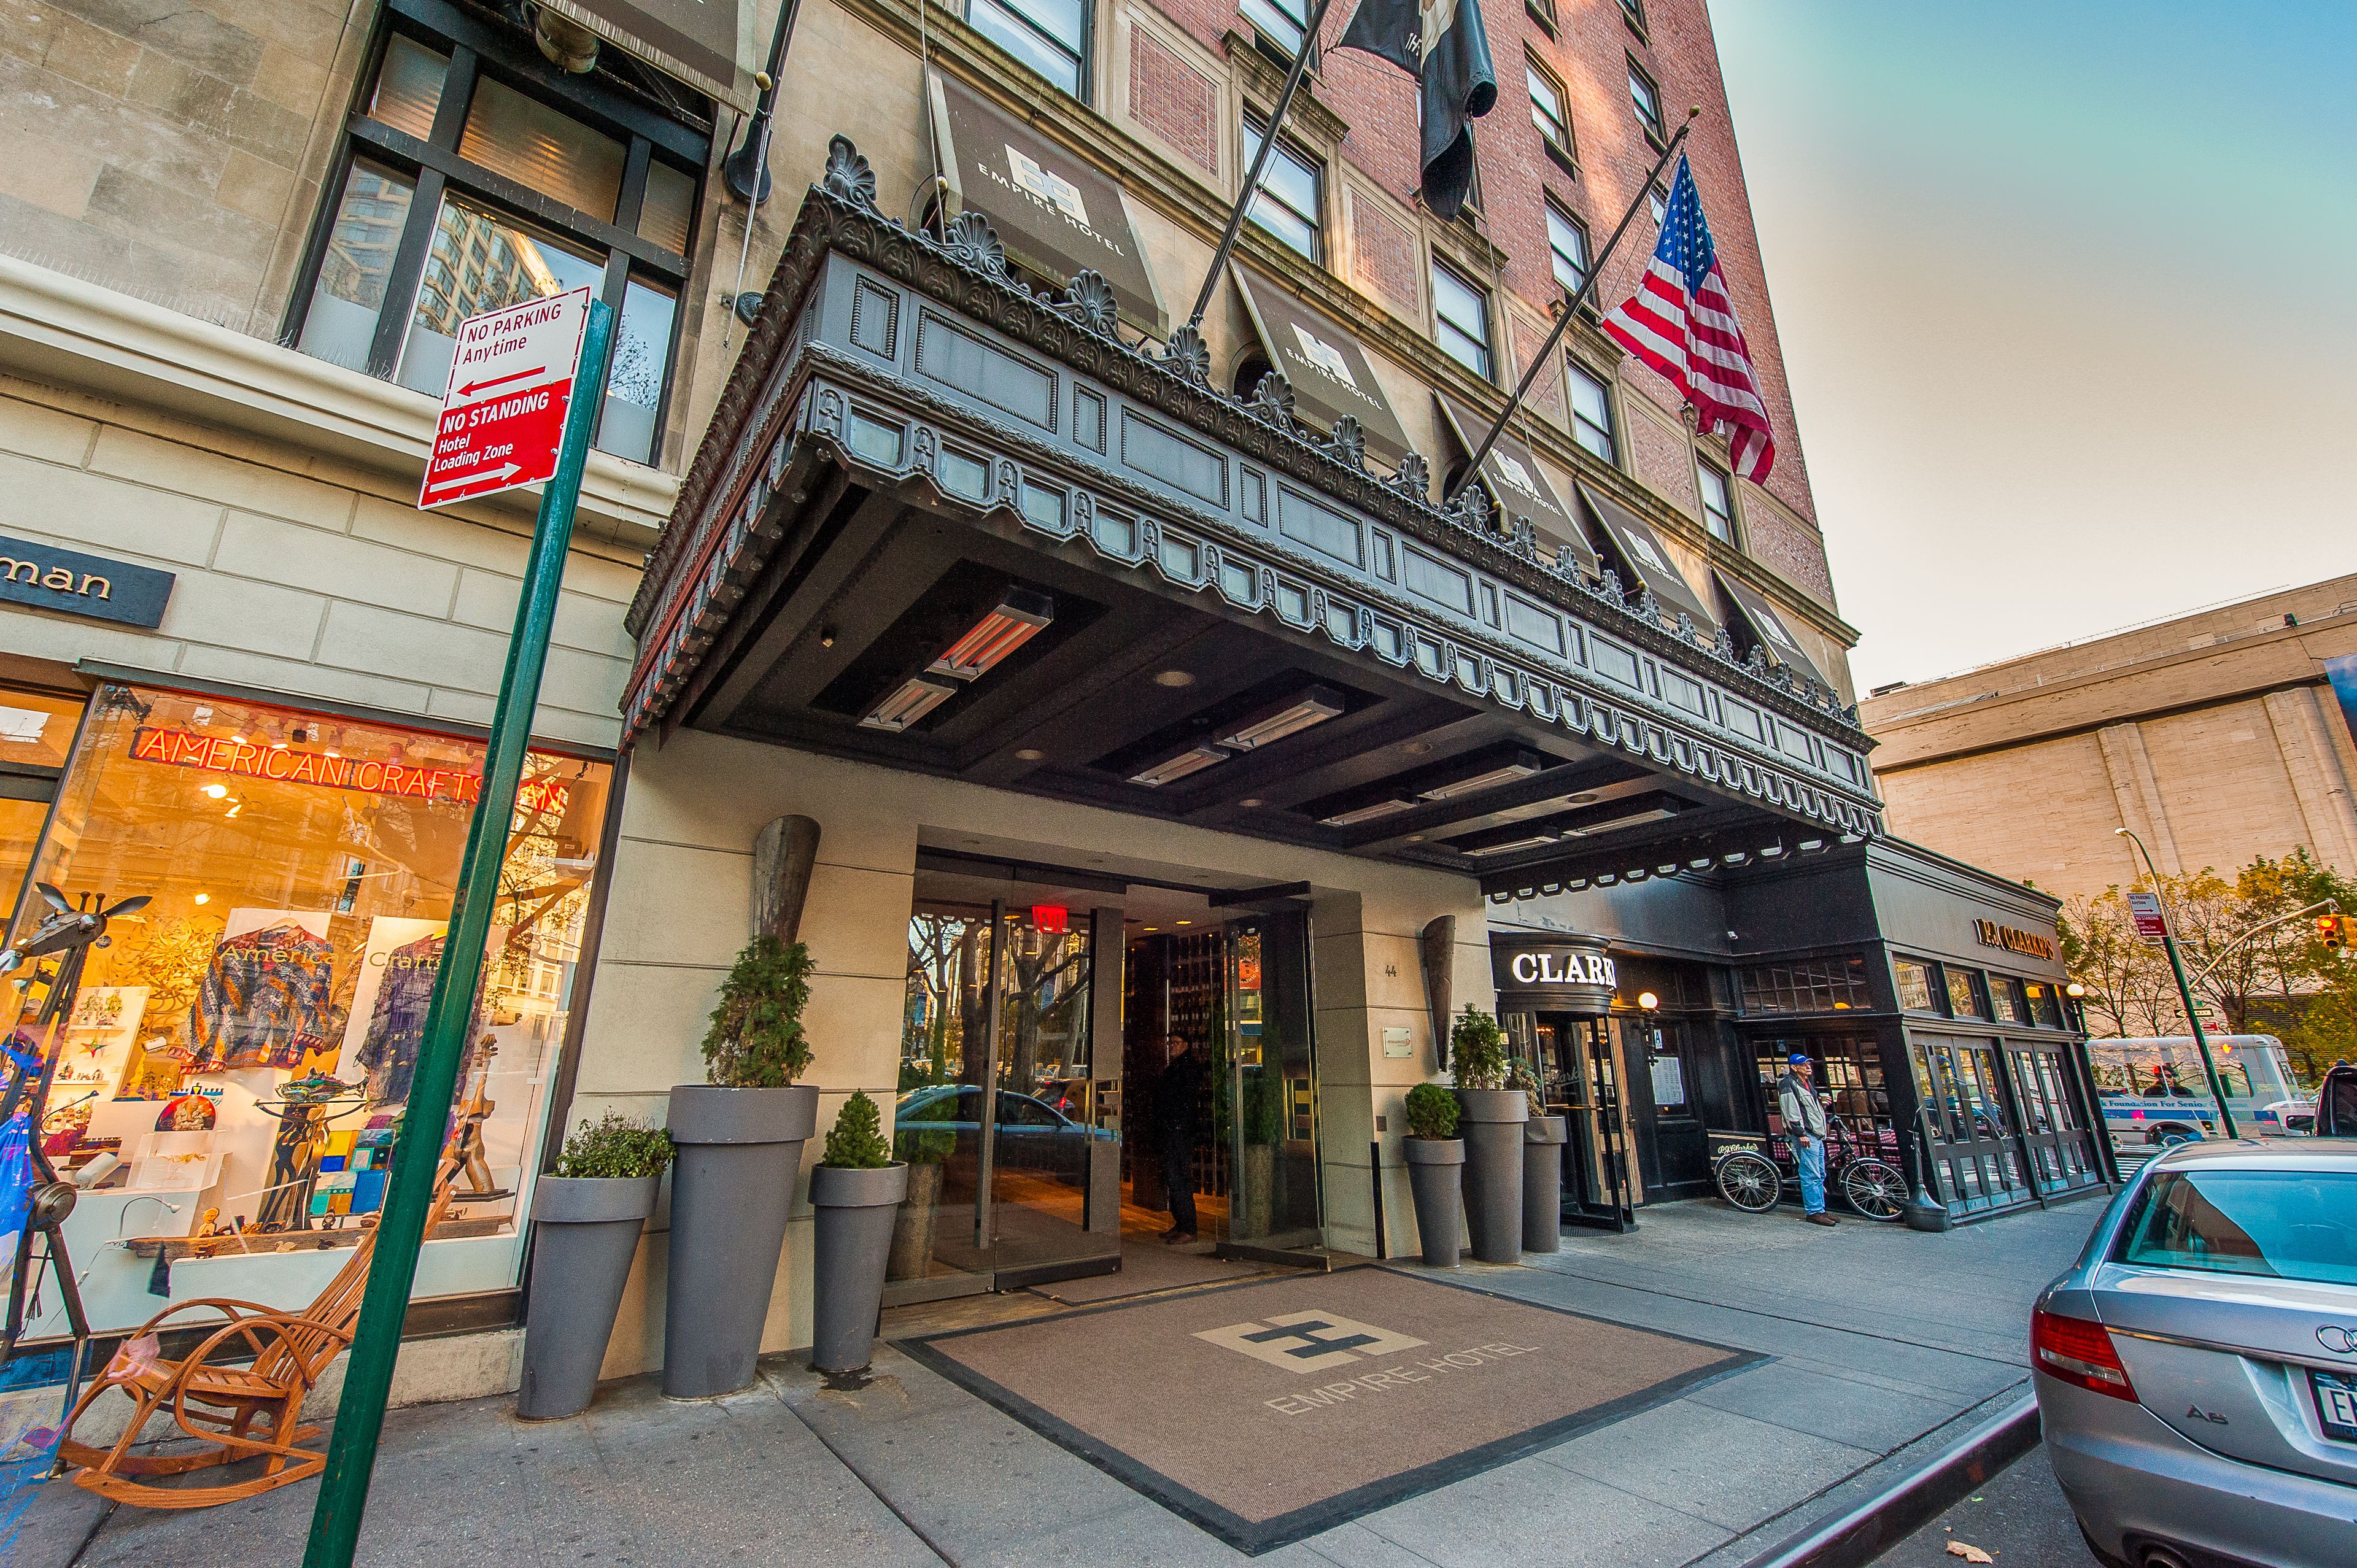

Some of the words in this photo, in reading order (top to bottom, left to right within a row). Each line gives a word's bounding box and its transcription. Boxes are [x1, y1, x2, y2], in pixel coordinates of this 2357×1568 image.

[978, 162, 1056, 216] EMPIRE
[1064, 214, 1124, 257] HOTEL
[467, 326, 487, 344] NO
[493, 303, 562, 337] PARKING
[463, 335, 527, 365] Anytime
[1285, 347, 1338, 384] EMPIRE
[1341, 380, 1383, 411] HOTEL
[443, 413, 465, 434] NO
[468, 392, 549, 428] STANDING
[434, 448, 480, 473] Loading
[482, 443, 513, 461] Zone
[438, 433, 471, 454] Hotel
[1493, 472, 1531, 499] EMPIRE
[139, 730, 346, 786] AMERICAN
[358, 762, 562, 811] CRAFTSAN
[369, 952, 491, 971] Craftsn
[1385, 965, 1397, 977] 44
[1512, 953, 1617, 989] CLARK
[1655, 1032, 1660, 1043] A
[1263, 1366, 1431, 1415] EMPIRE
[1418, 1342, 1541, 1373] HOTEL
[2187, 1404, 2229, 1424] A6
